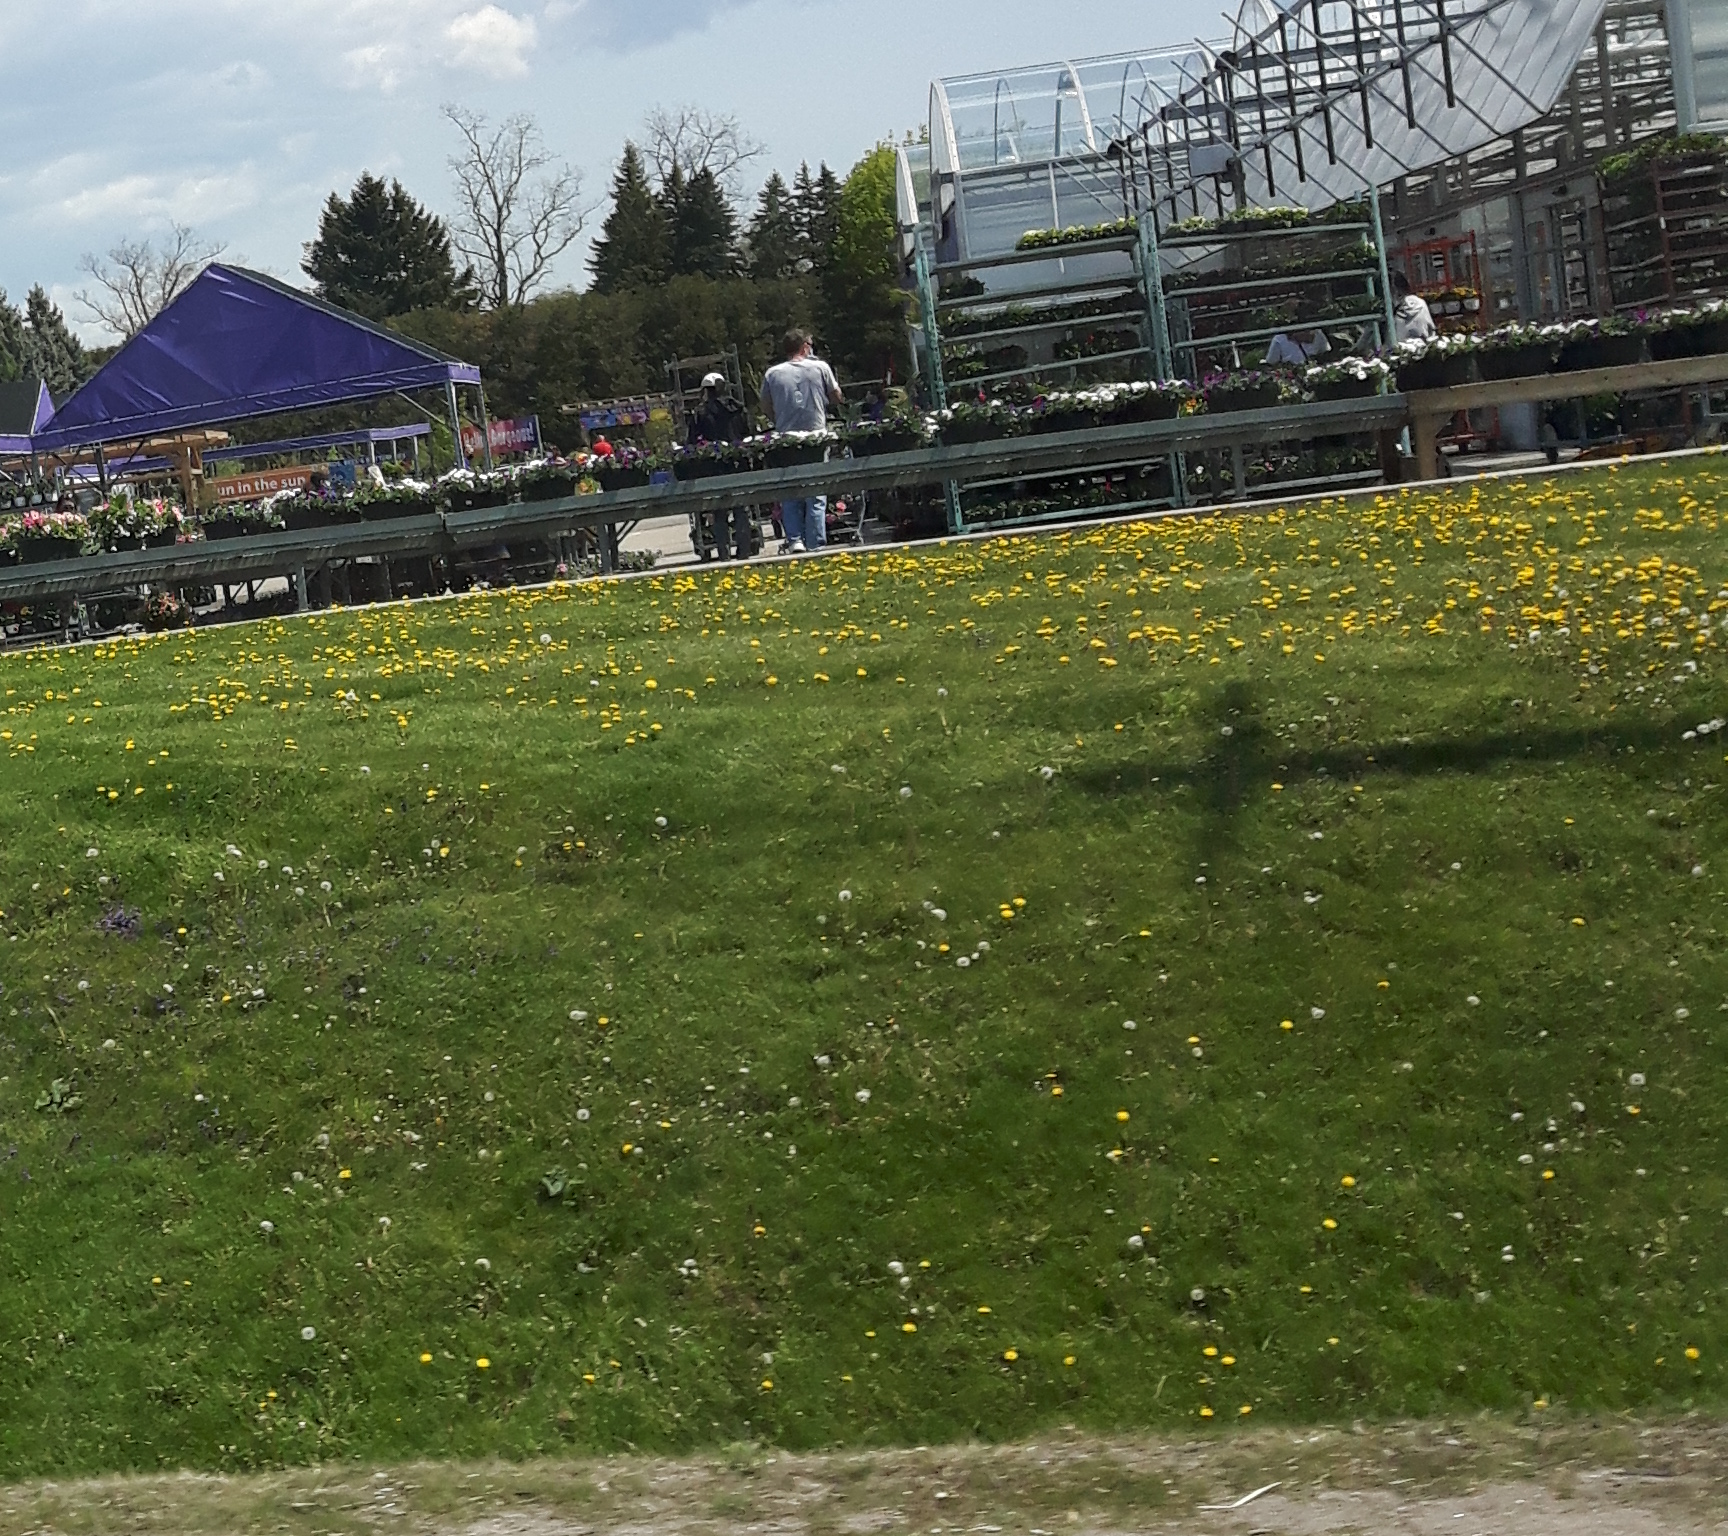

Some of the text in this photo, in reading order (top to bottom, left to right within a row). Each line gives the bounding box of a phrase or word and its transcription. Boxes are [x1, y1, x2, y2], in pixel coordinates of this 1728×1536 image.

[238, 481, 251, 494] in
[255, 478, 278, 491] the
[281, 475, 307, 489] sun
